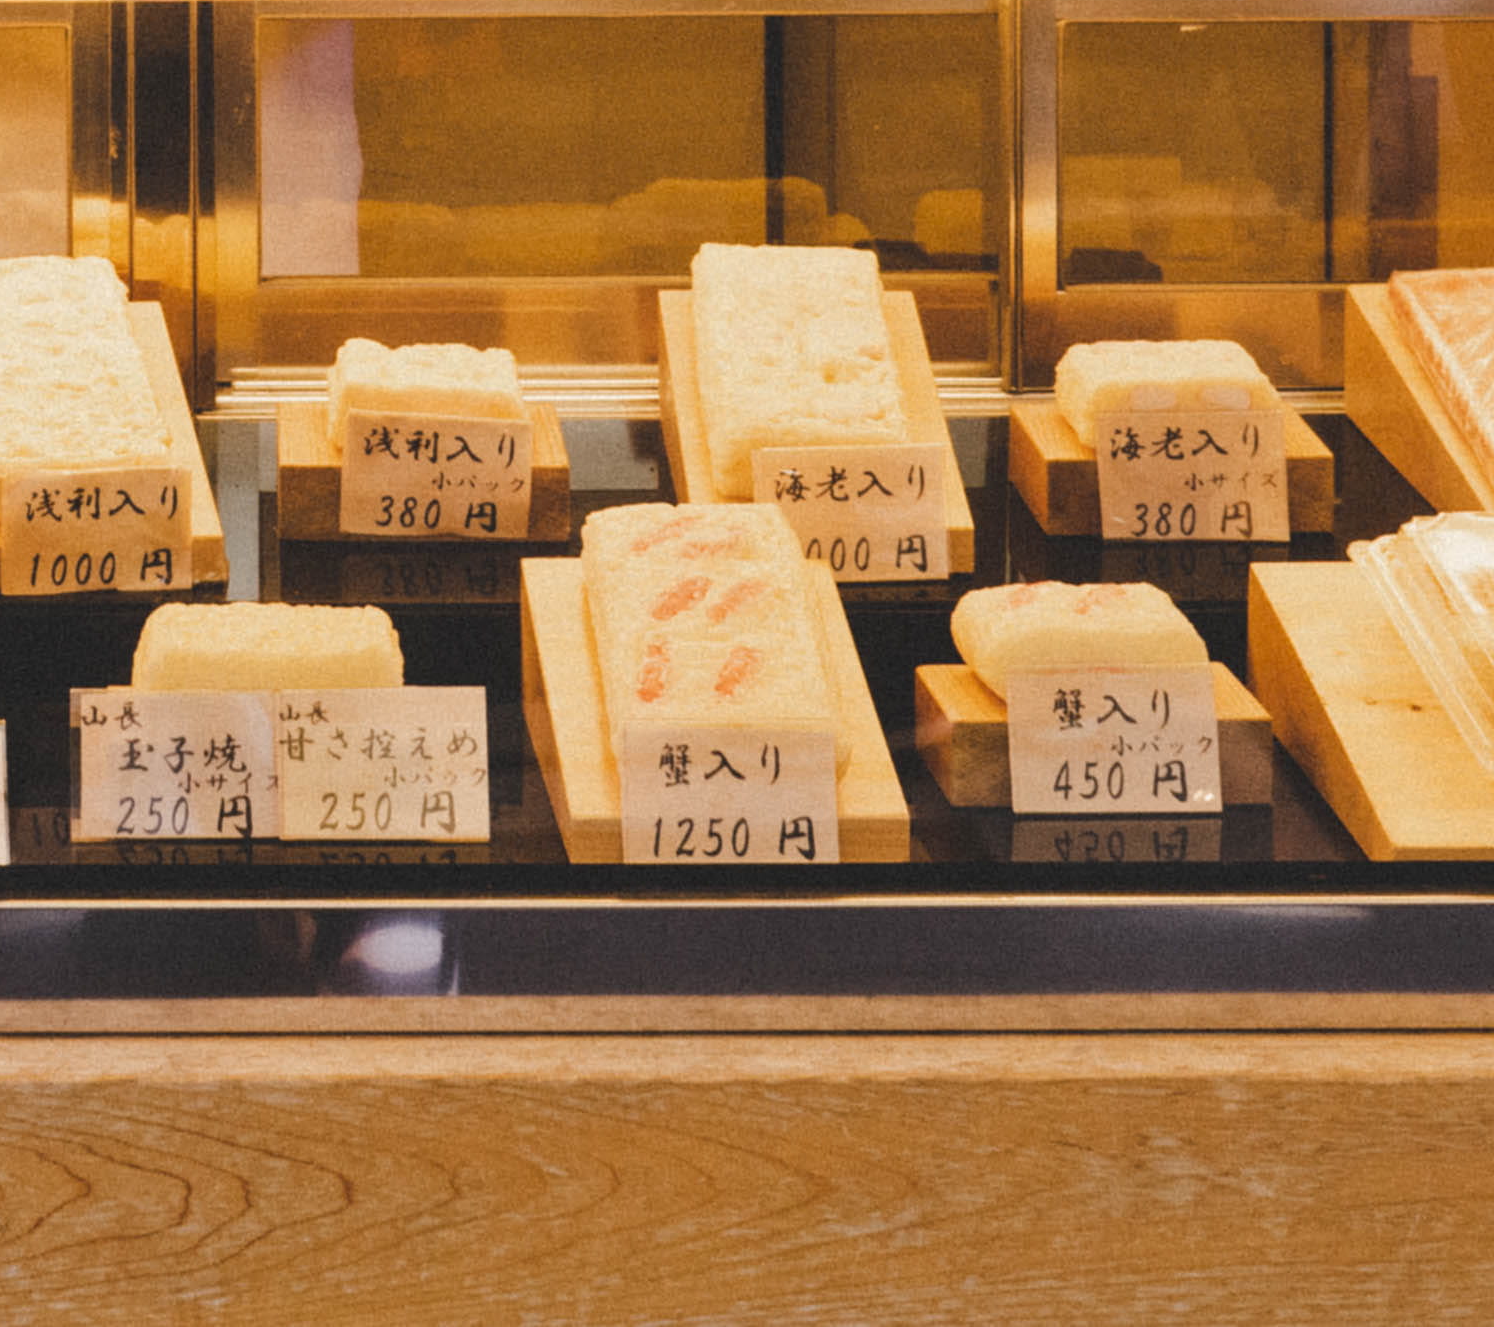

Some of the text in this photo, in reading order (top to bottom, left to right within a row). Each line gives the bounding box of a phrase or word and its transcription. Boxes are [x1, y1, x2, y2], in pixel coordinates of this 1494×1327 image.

[364, 426, 515, 469] 浅利入り
[1110, 423, 1259, 461] 海老入り
[775, 464, 926, 503] 海老入り
[26, 485, 178, 522] 浅利入り
[375, 496, 497, 533] 380円
[1131, 500, 1253, 539] 380円
[31, 548, 172, 587] 1000円
[82, 702, 143, 731] 山長
[278, 702, 330, 724] 山長
[1053, 689, 1170, 730] 蟹入り
[119, 734, 247, 773] 玉子焼
[278, 728, 479, 762] 甘さ控えめ
[659, 743, 781, 787] 蟹入り
[1053, 760, 1188, 802] 450円
[116, 793, 253, 839] 250円
[319, 791, 457, 834] 250円
[654, 816, 816, 860] 1250円
